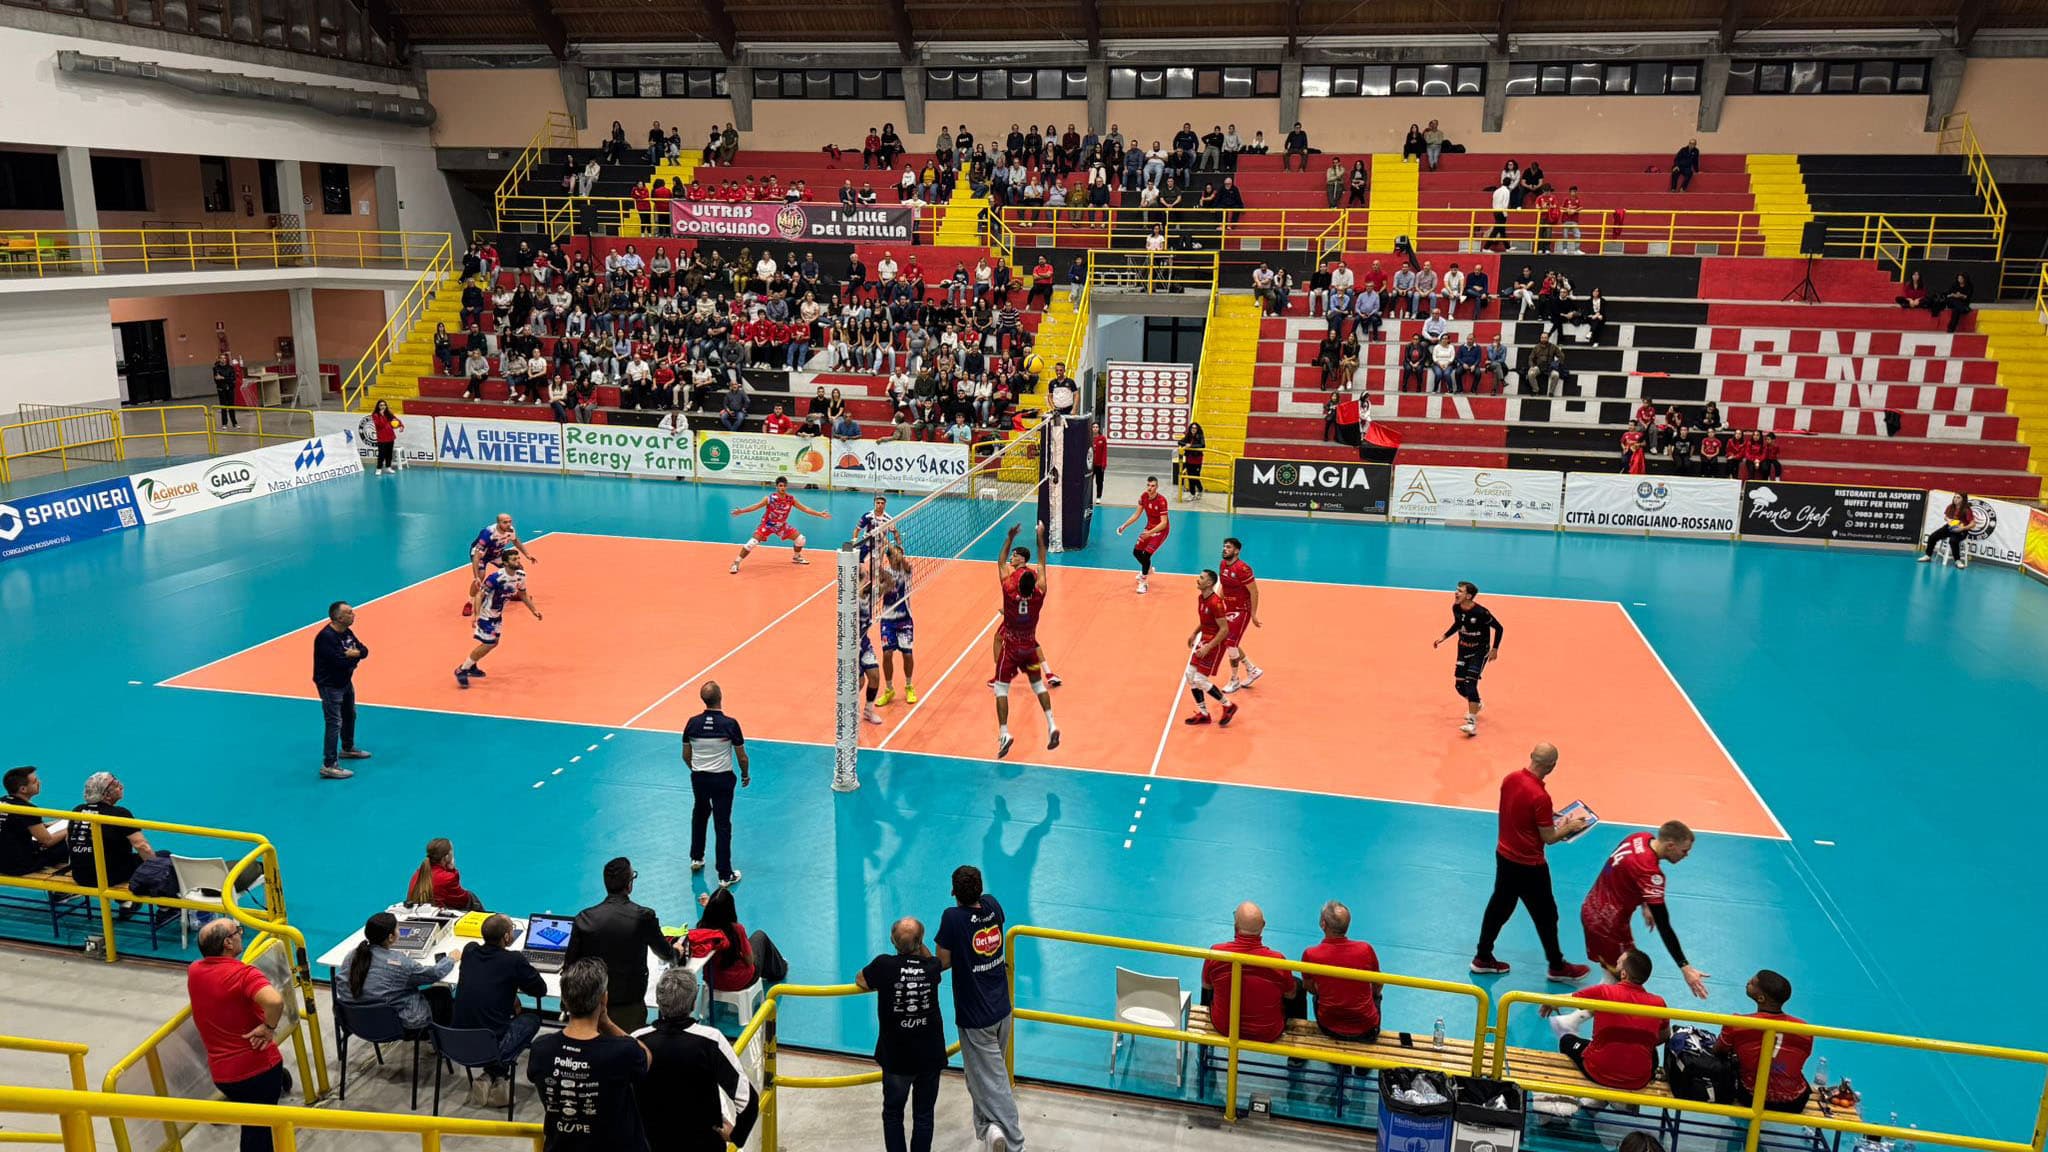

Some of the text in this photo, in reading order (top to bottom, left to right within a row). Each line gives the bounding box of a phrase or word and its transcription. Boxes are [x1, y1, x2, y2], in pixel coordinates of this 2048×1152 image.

[692, 204, 753, 218] ULTRAS
[831, 210, 887, 223] I MILLE
[675, 219, 771, 237] CORIGLIANO
[811, 223, 842, 236] DEL
[846, 224, 907, 238] BRILLIA
[477, 429, 560, 446] GIUSEPPE
[566, 427, 689, 451] Renovare
[478, 442, 561, 465] MIELE
[566, 447, 693, 472] Energy Farm
[211, 468, 250, 488] GALLO
[267, 479, 293, 493] Max
[295, 461, 360, 487] Automazioni
[152, 481, 200, 503] AGRICOR
[1834, 489, 1921, 501] RISTORANTE DA ASPORTO
[25, 487, 131, 526] SPROVIERI
[1844, 499, 1909, 510] BUFFET PER EVENTI
[1566, 510, 1733, 531] CITTÀ DI CORIGLIANO-ROSSANO
[1749, 504, 1833, 527] Pronto Chef
[900, 1017, 928, 1028] GUPE
[557, 1121, 591, 1134] GUPE
